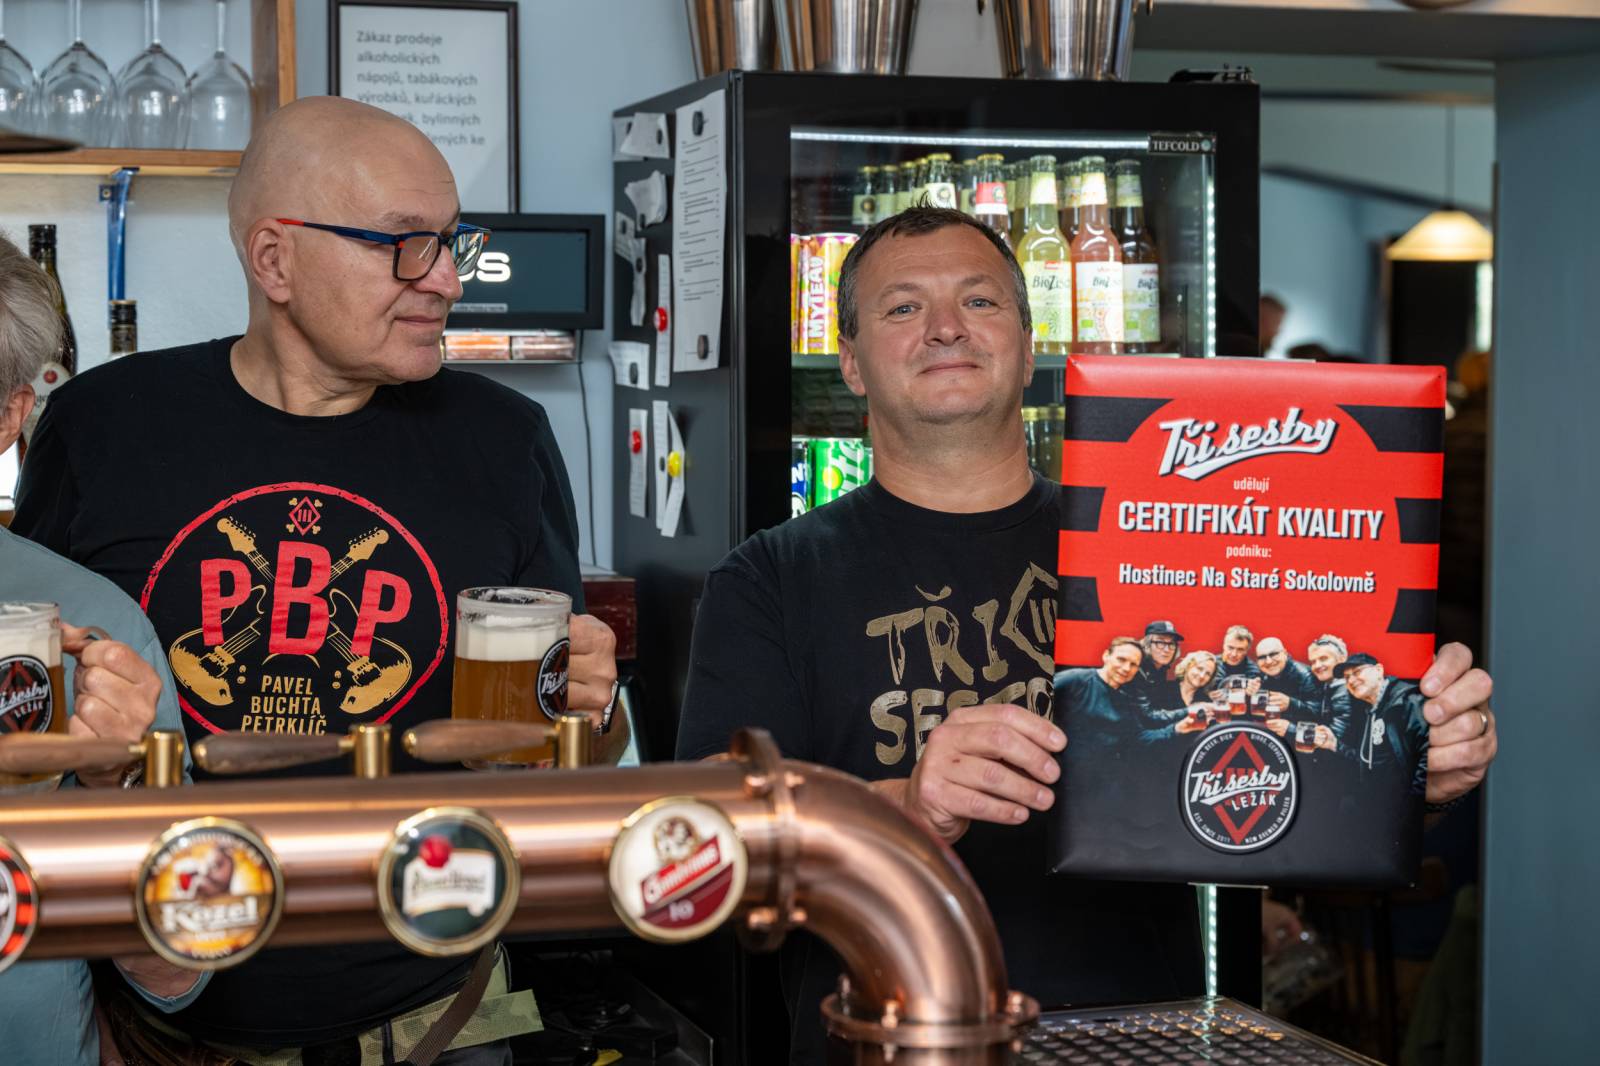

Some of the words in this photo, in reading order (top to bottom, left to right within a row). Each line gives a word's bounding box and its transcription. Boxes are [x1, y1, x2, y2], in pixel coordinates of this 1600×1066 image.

[356, 29, 391, 43] Zákaz
[395, 33, 442, 47] prodeje
[357, 50, 440, 65] alkoholických
[407, 73, 478, 87] tabákových
[1152, 140, 1200, 152] TEFCOLD
[1158, 417, 1219, 477] Tři
[1215, 407, 1336, 455] sestry
[1233, 476, 1269, 493] udělují
[1118, 498, 1270, 536] CERTIFIKÁT
[1277, 507, 1385, 540] KVALITY
[1225, 544, 1272, 560] podniku:
[1119, 563, 1196, 587] Hostinec
[1202, 566, 1224, 587] Na
[1231, 567, 1279, 589] Staré
[1284, 568, 1375, 593] Sokolovně
[260, 674, 313, 696] PAVEL
[250, 696, 321, 715] BUCHTA
[240, 714, 328, 737] PETRKLÍČ
[1190, 770, 1224, 804] Tři
[1223, 765, 1291, 792] sestry
[1231, 792, 1276, 811] LEŽÁK
